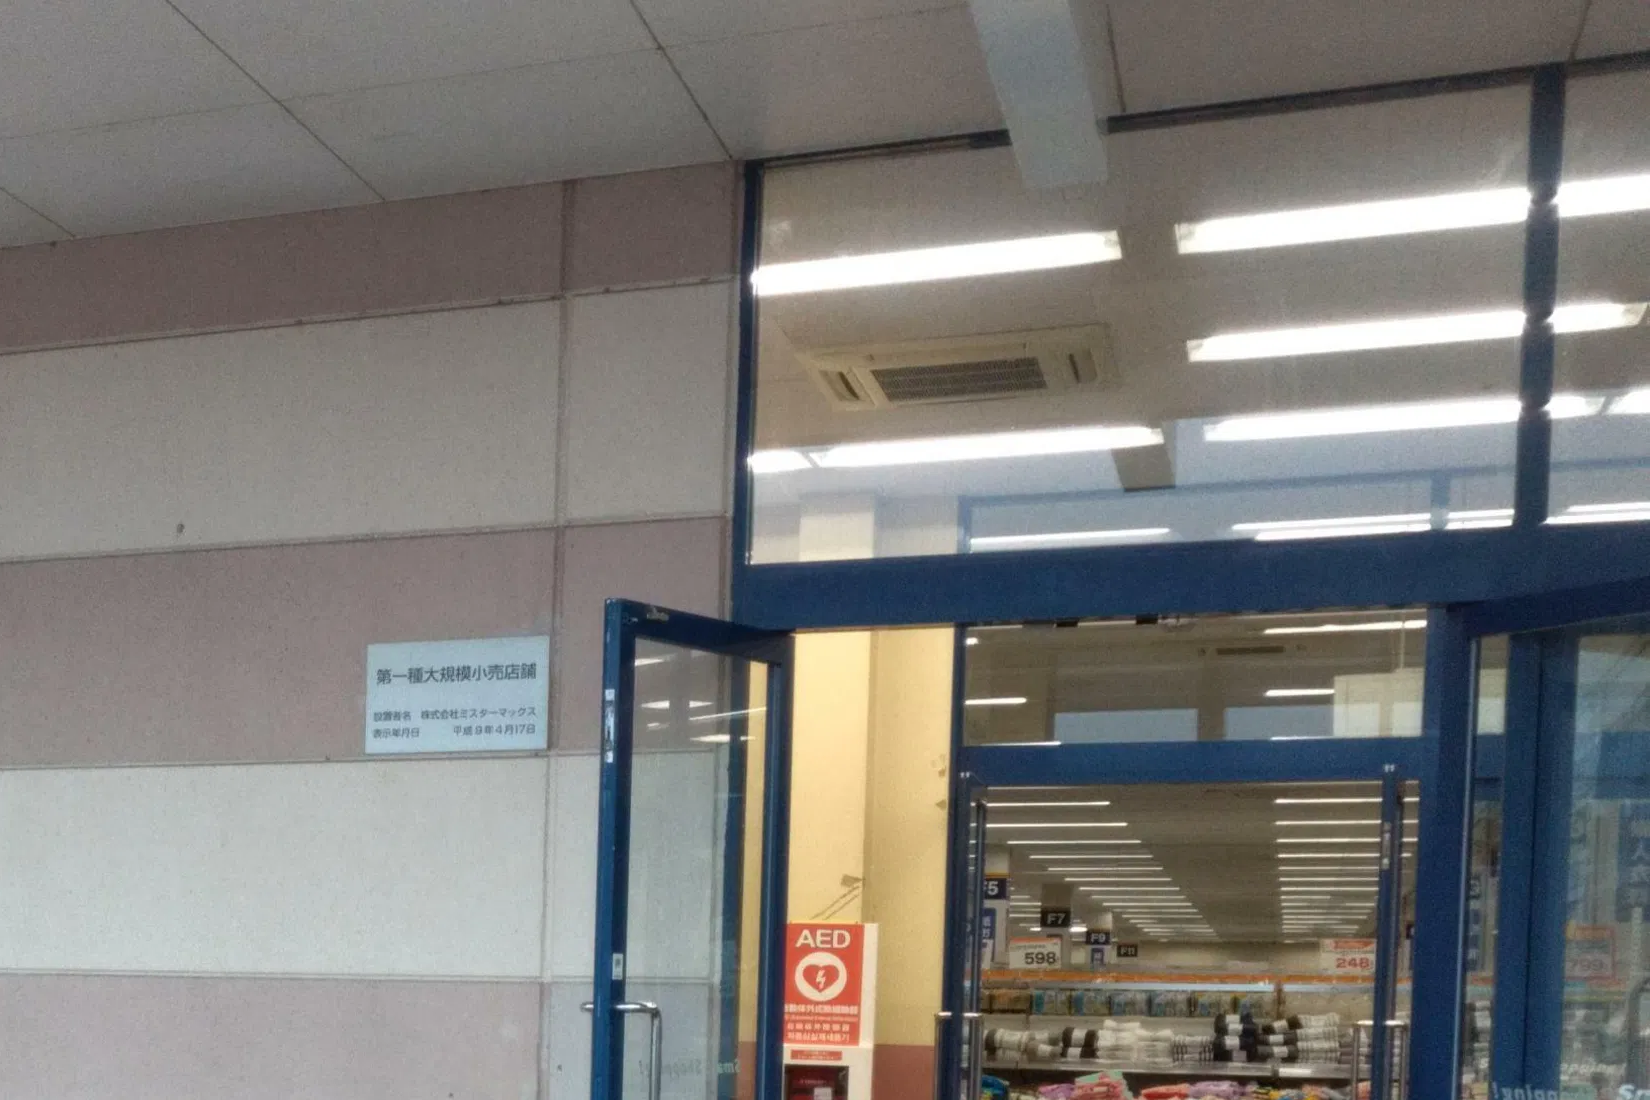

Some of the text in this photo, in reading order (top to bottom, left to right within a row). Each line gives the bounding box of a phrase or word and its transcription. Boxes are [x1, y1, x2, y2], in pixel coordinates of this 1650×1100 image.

[376, 663, 537, 685] 第一種大規模小売店舗
[420, 707, 537, 720] 株式会社ミスターマックス
[1047, 913, 1067, 925] F7
[795, 929, 851, 949] AED
[1024, 951, 1056, 965] 598
[1336, 957, 1370, 969] 248
